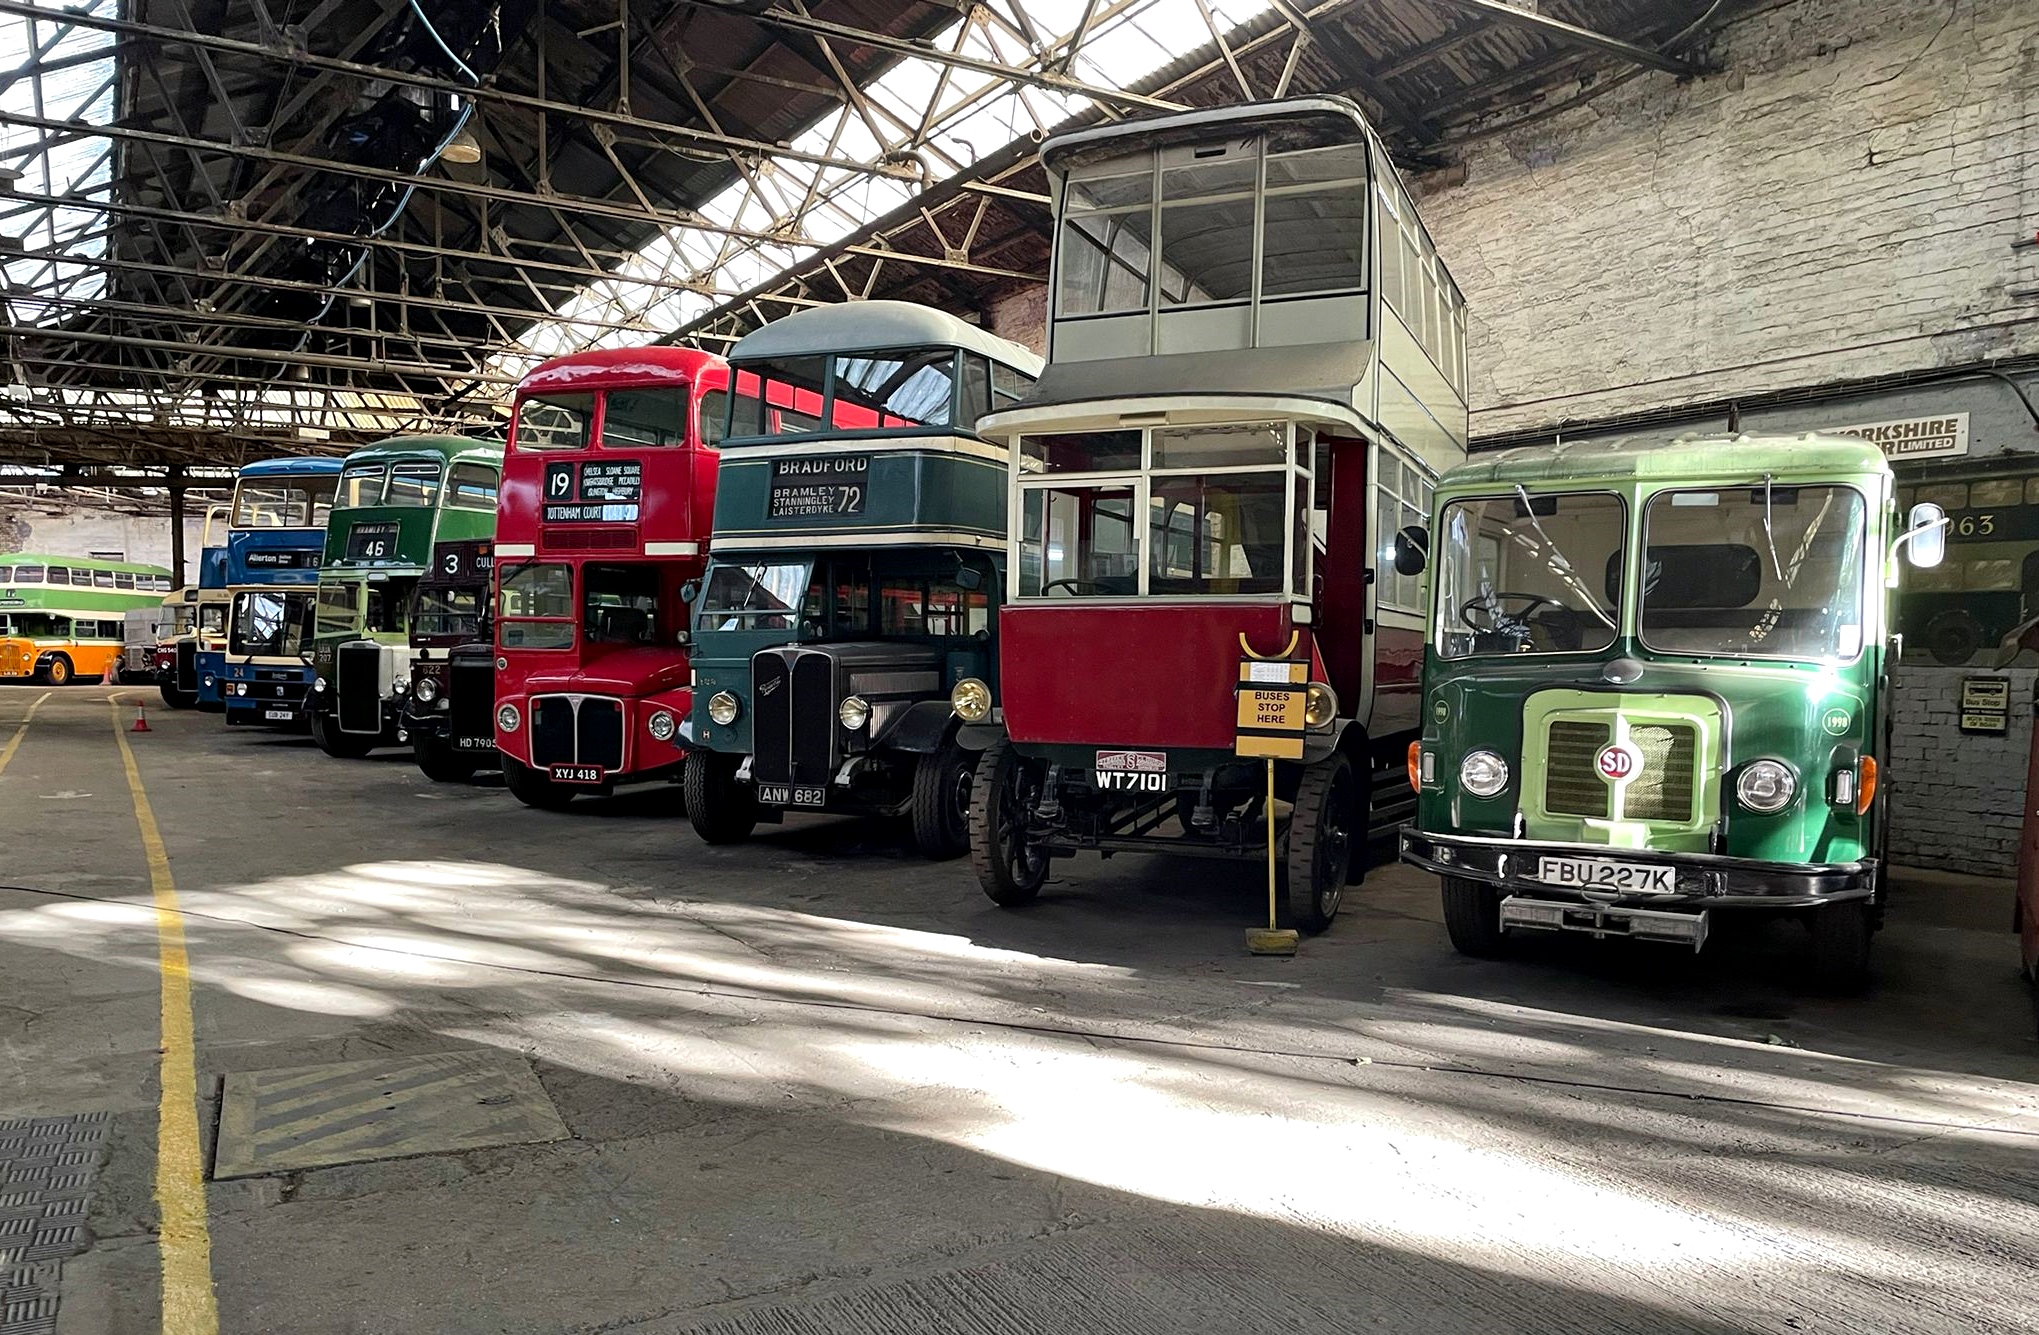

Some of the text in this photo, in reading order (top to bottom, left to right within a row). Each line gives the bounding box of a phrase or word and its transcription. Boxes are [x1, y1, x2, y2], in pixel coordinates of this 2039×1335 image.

[1837, 418, 1958, 442] RKSHIRE
[1900, 437, 1953, 452] LIMITED
[623, 465, 640, 474] SQUARE
[780, 458, 867, 474] BRADFORD
[551, 472, 569, 496] 19
[774, 486, 835, 498] BRAMLEY
[773, 496, 834, 507] STANNINGLEY
[837, 486, 861, 513] 72
[547, 506, 581, 520] TOTTENHAM
[582, 506, 602, 519] COURT
[773, 504, 834, 516] LAISTERDYKE
[366, 541, 385, 557] 46
[249, 553, 277, 562] Allerton
[476, 557, 495, 568] CULL
[445, 554, 459, 574] 3
[234, 668, 244, 678] 24
[1255, 691, 1290, 701] BUSES
[1258, 703, 1286, 712] STOP
[1257, 714, 1285, 723] HERE
[1827, 716, 1848, 728] 1998
[702, 730, 710, 739] H
[460, 738, 497, 748] HD 7905
[1601, 751, 1630, 772] SD
[555, 768, 597, 780] XYJ 418
[1096, 771, 1167, 791] WT7101
[762, 787, 821, 804] ANW 682
[1543, 861, 1669, 891] FBU 227K
